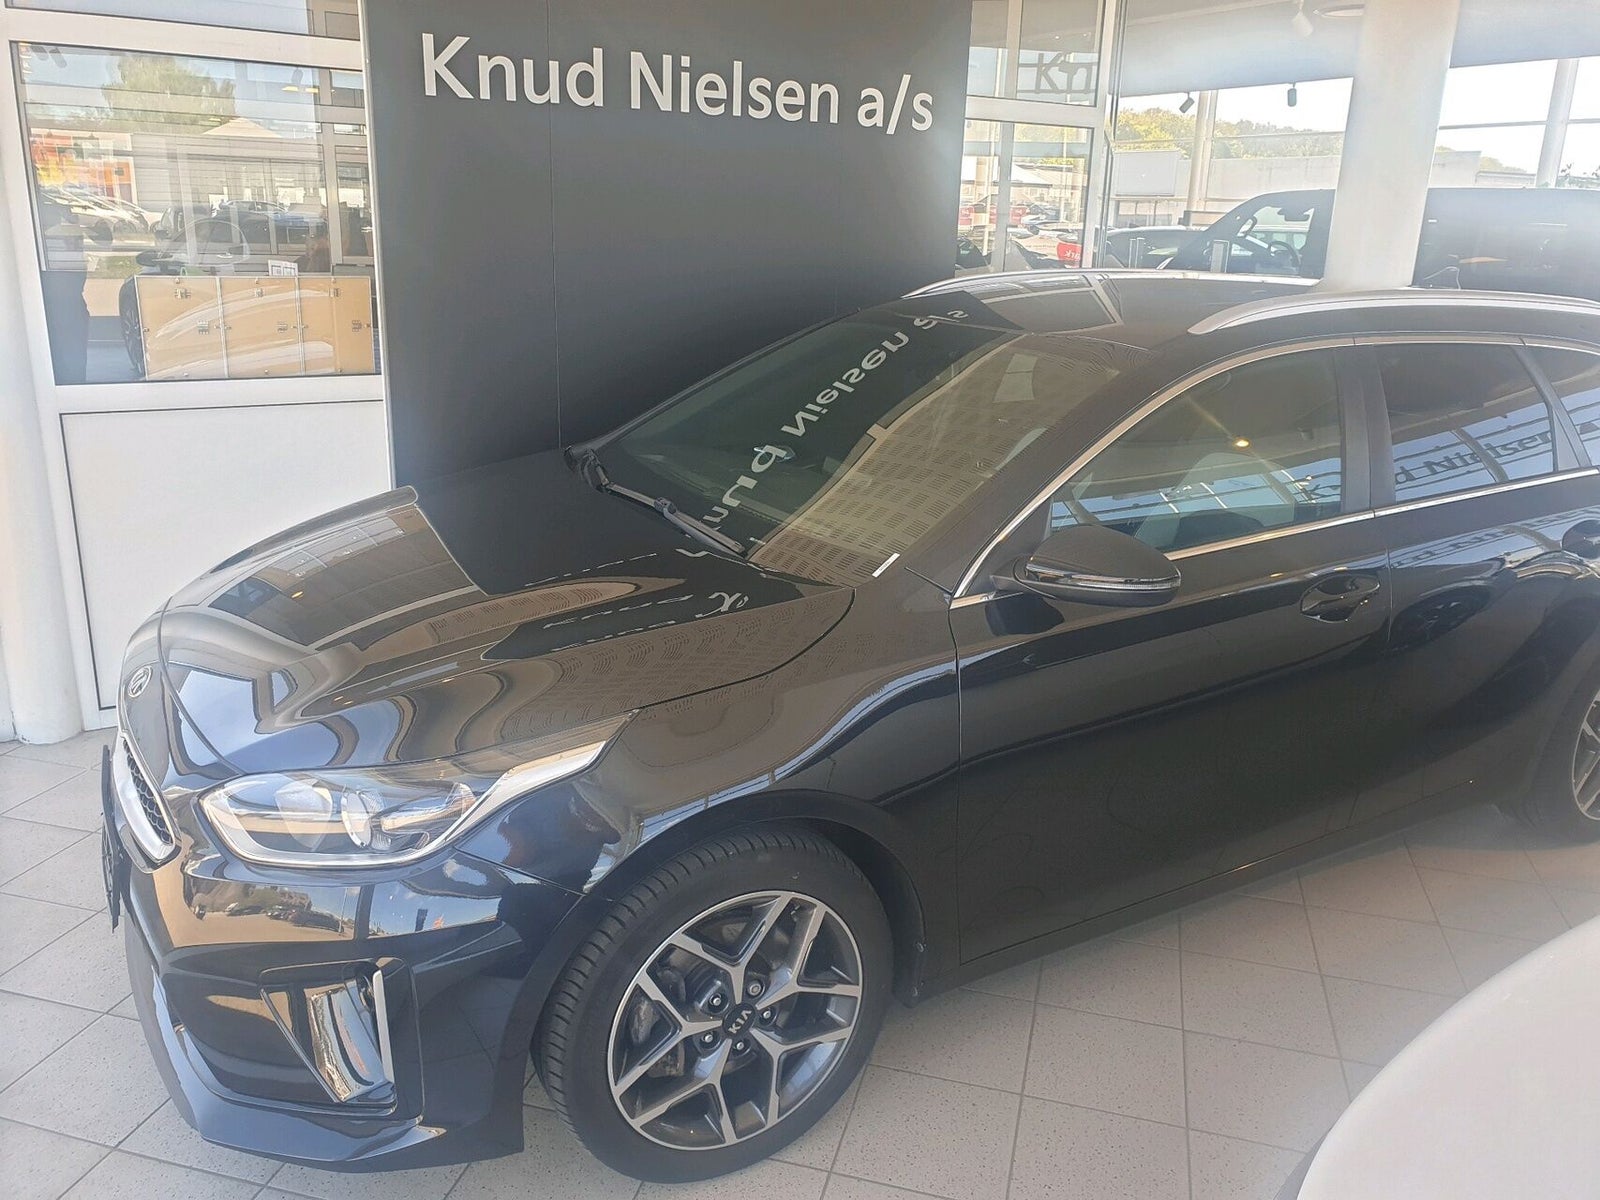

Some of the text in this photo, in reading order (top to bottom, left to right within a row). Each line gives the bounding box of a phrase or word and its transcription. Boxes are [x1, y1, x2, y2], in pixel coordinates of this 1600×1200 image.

[421, 32, 934, 135] Knud Nielsen a/s
[728, 1010, 752, 1034] KIA
